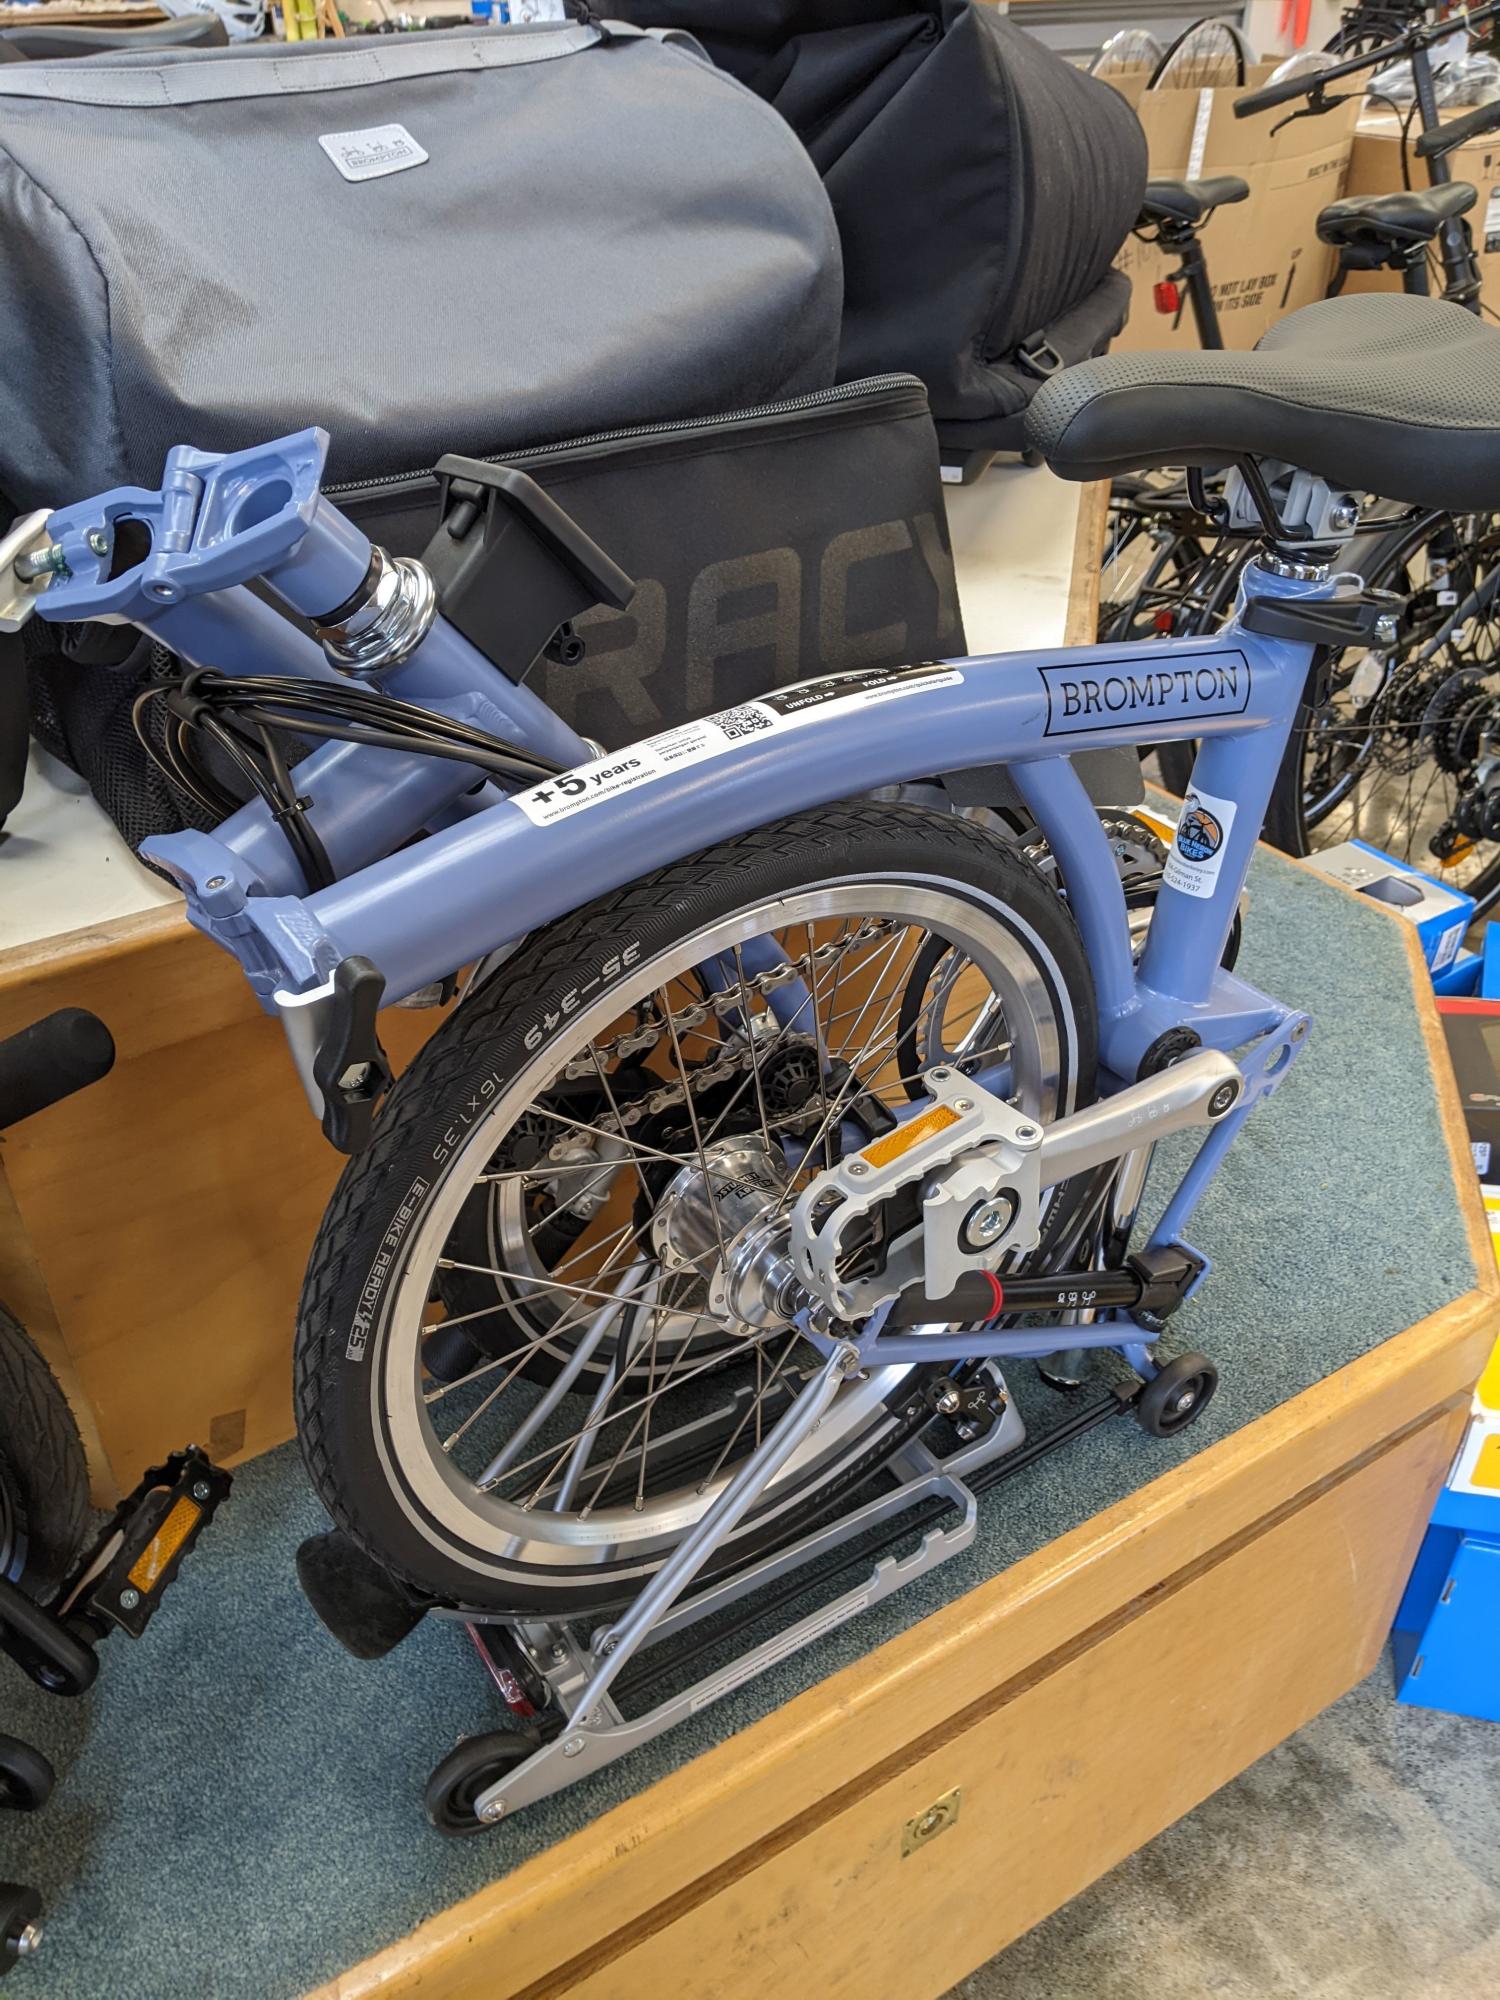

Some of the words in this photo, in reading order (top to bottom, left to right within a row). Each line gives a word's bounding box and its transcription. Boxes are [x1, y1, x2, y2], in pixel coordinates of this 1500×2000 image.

[1259, 272, 1279, 289] BOX
[1241, 291, 1264, 308] SIDE
[861, 677, 887, 689] FOLD
[1060, 666, 1238, 716] BROMPTON
[785, 693, 824, 710] UNFOLD
[531, 773, 587, 804] +5
[589, 758, 641, 786] years
[543, 767, 657, 820] www.brompton.com/bike-registration
[1180, 842, 1205, 859] BIKES
[719, 1172, 760, 1198] STUMEY
[386, 1184, 424, 1248] E-BIKE
[361, 1251, 391, 1311] READY
[351, 1324, 369, 1350] 25
